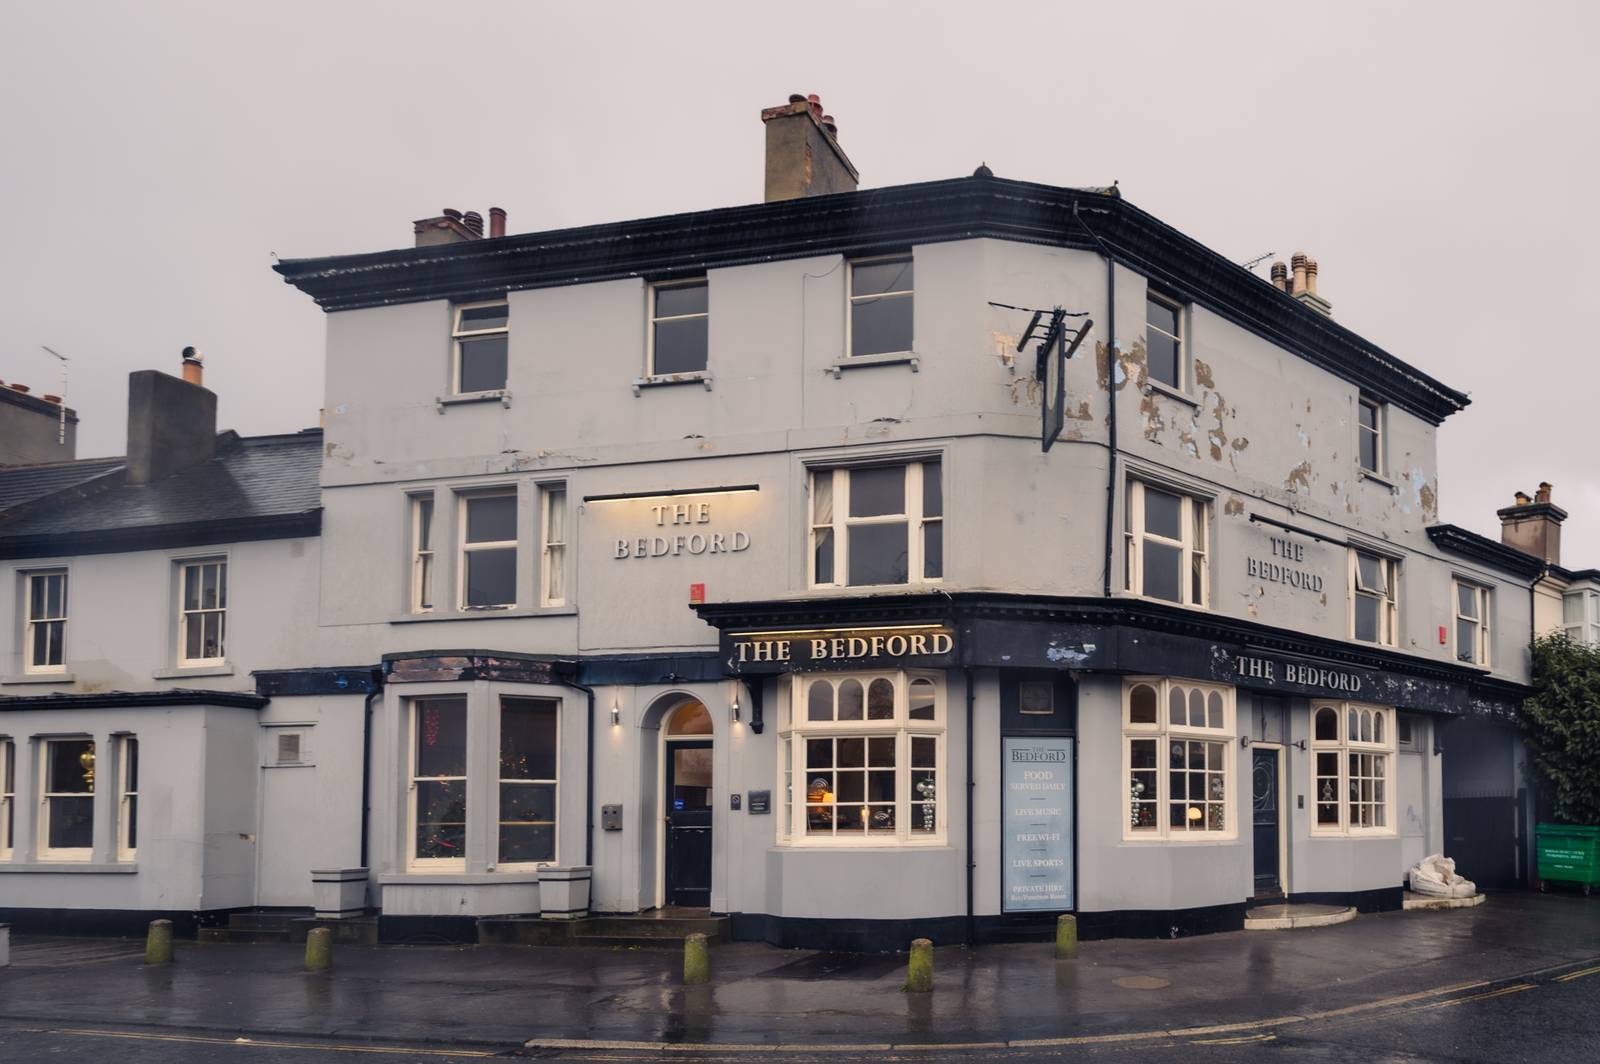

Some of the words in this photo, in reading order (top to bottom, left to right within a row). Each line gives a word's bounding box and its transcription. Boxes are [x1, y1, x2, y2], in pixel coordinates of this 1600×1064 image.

[652, 502, 710, 526] THE
[614, 532, 750, 559] BEDFORD
[1270, 536, 1303, 562] THE
[1247, 556, 1323, 592] BEDFORD
[734, 641, 791, 662] THE
[810, 633, 953, 660] BEDFORD
[1236, 655, 1275, 679] THE
[1285, 663, 1361, 692] BEDFORD
[1012, 751, 1066, 761] BEDFORD
[1024, 770, 1053, 780] FOOD
[1015, 808, 1034, 816] LIVE
[1035, 807, 1061, 816] MUSIC
[1012, 859, 1033, 867] LIVE
[1034, 858, 1064, 867] SPORTS
